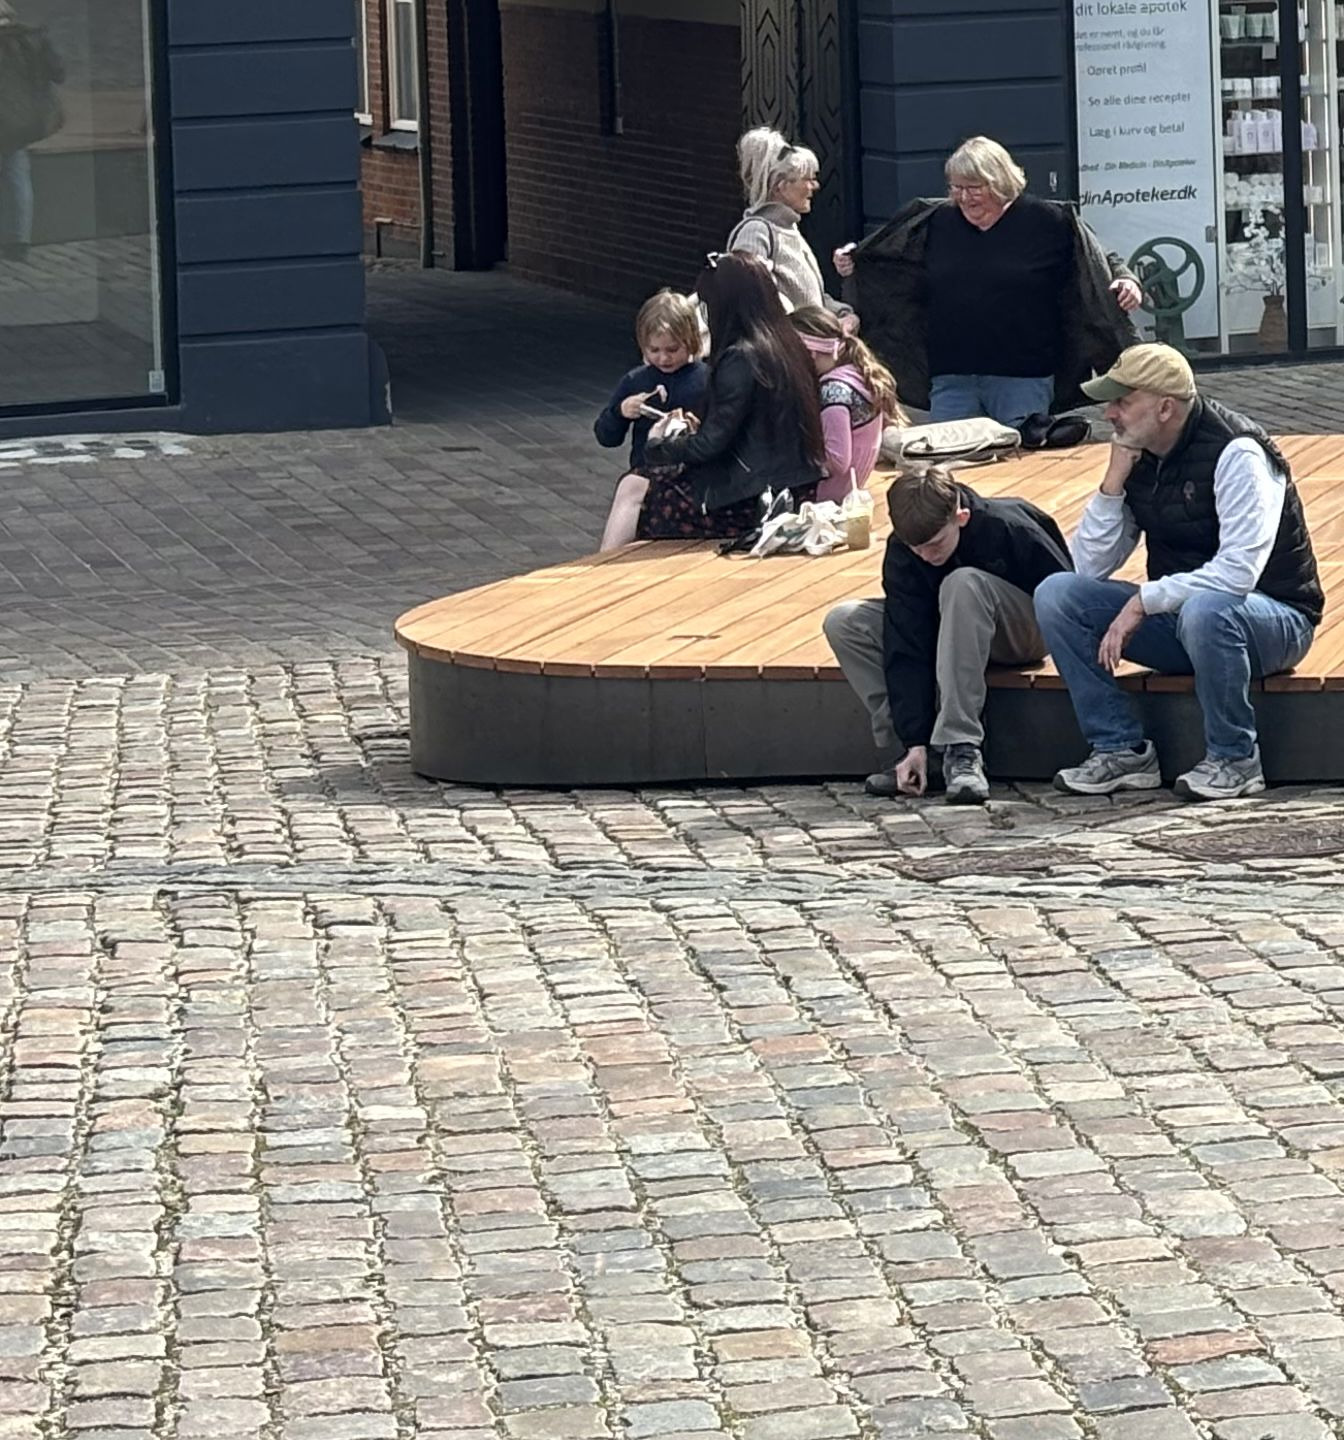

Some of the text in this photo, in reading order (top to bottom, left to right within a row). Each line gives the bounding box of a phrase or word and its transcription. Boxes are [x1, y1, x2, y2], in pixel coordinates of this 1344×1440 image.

[1075, 0, 1188, 17] dit lokale apotek
[1143, 126, 1157, 137] og
